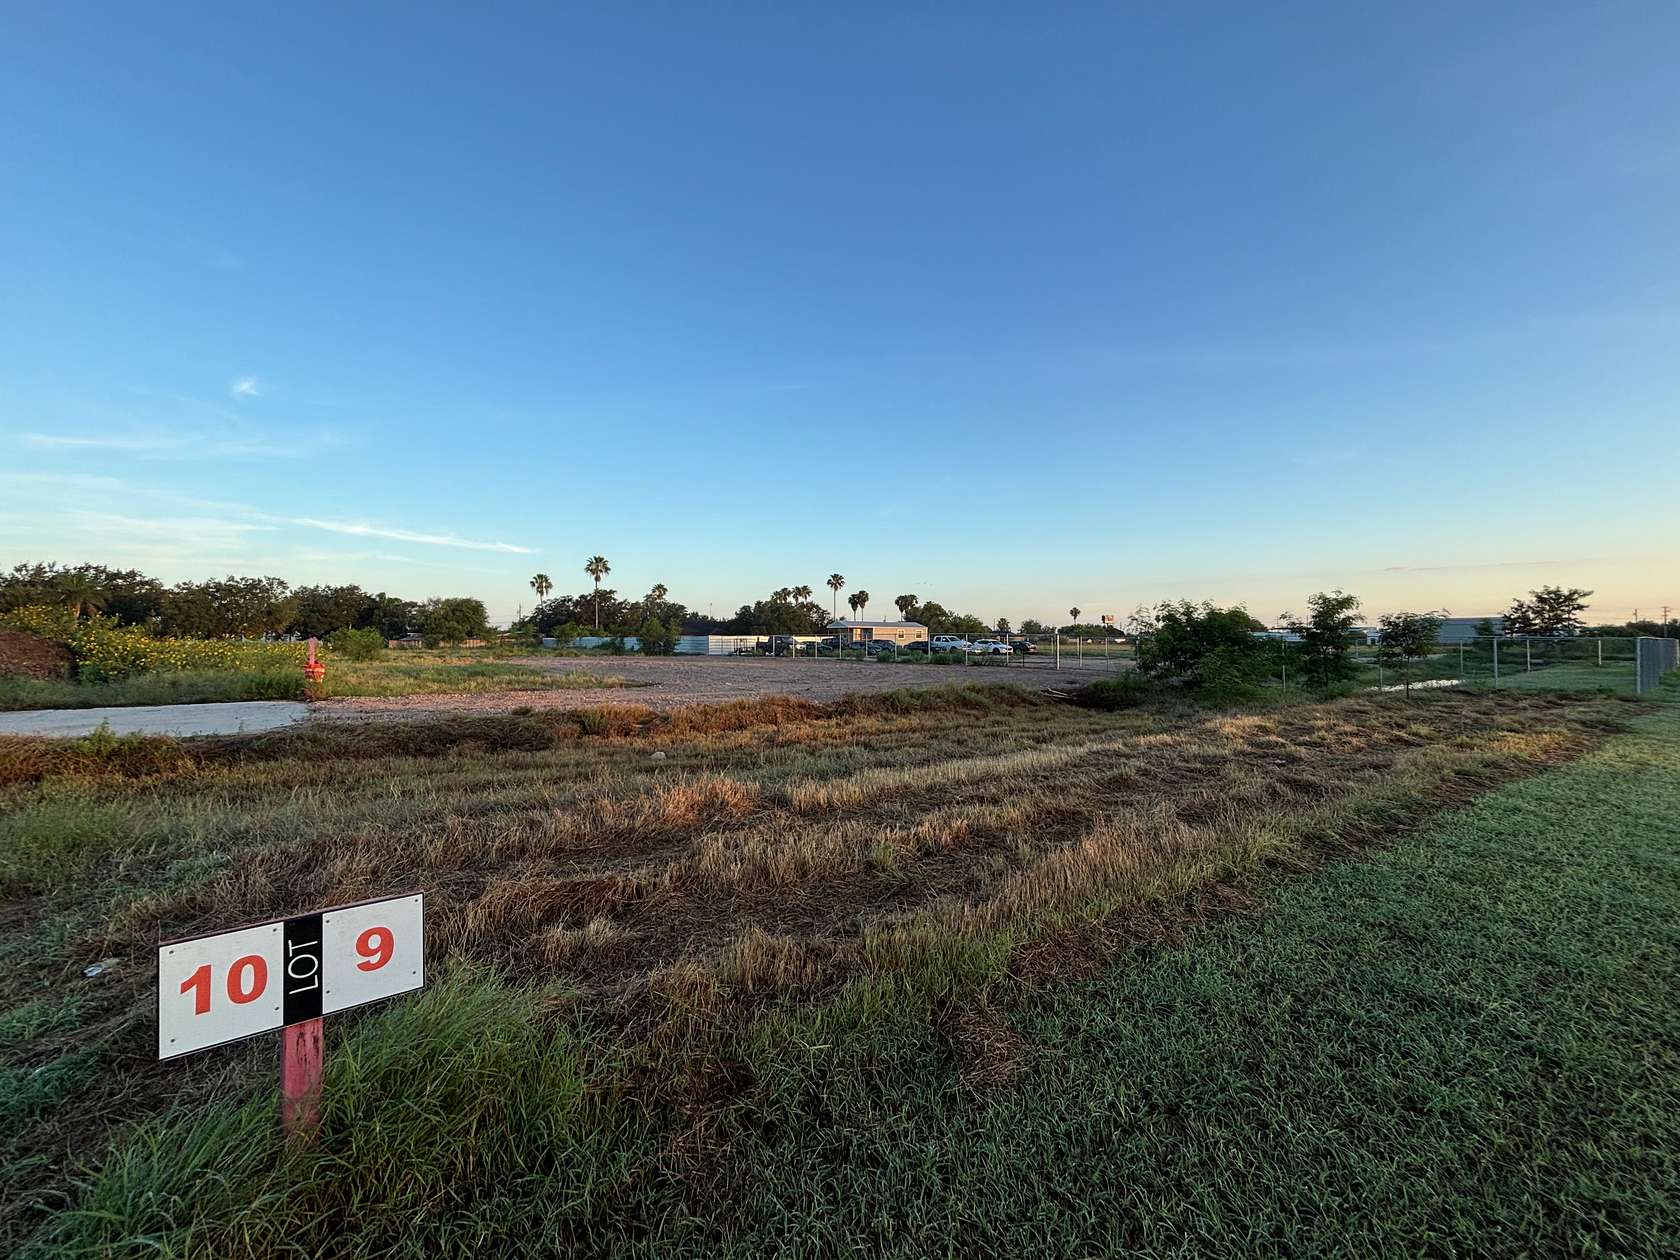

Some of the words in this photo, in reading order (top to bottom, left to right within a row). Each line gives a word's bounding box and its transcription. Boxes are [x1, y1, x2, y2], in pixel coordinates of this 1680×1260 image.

[288, 939, 319, 995] LOT
[355, 926, 395, 972] 9
[180, 954, 268, 1016] 10
